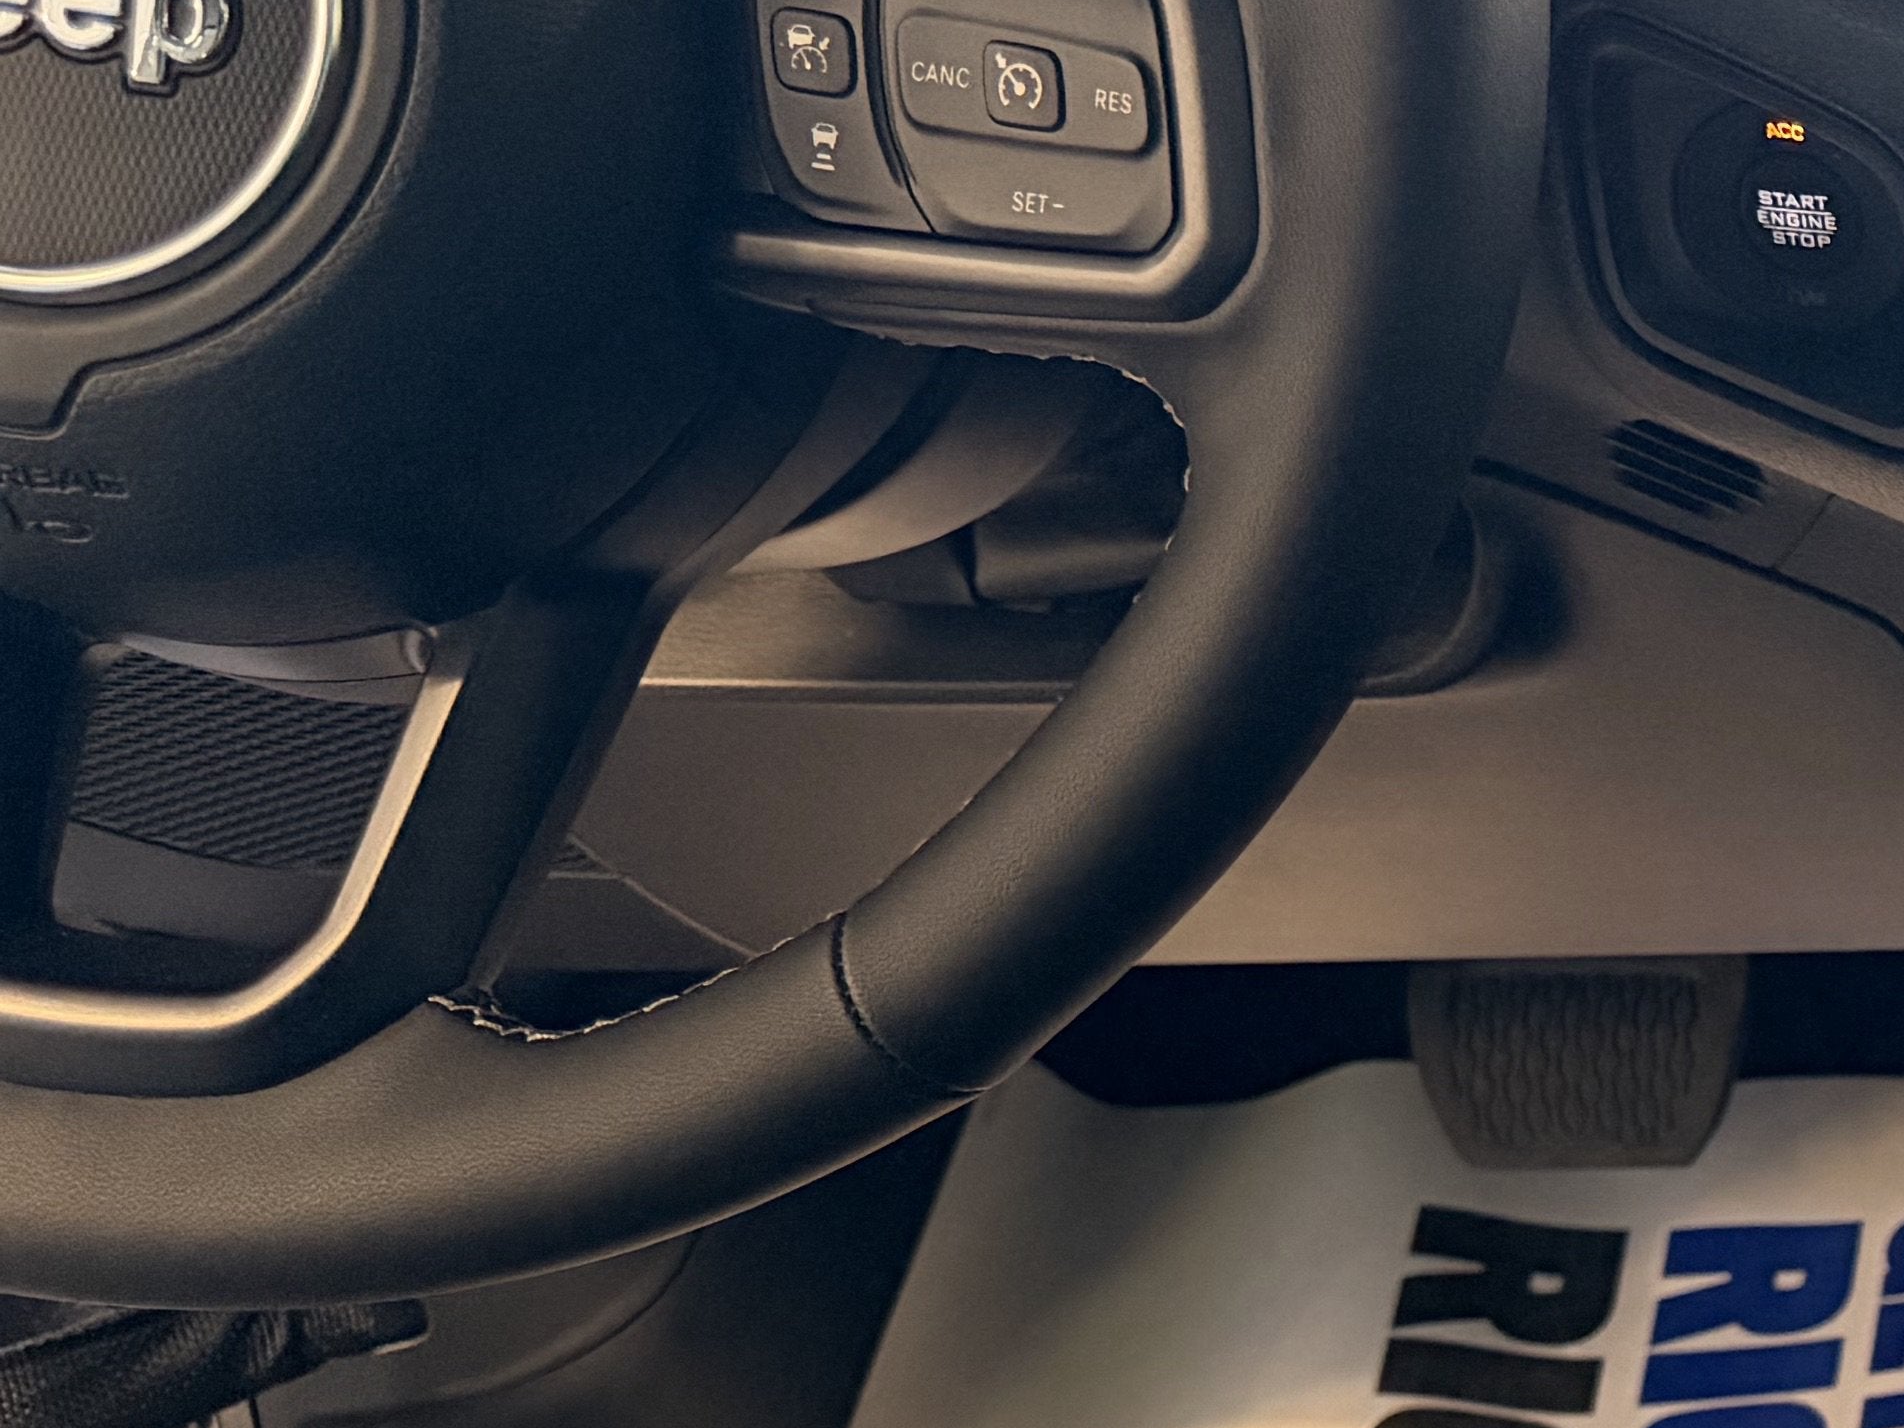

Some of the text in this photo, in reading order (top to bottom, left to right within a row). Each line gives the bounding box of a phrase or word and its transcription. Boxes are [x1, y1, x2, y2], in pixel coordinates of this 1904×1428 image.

[910, 62, 971, 88] CANC
[1094, 88, 1132, 115] RES
[1766, 121, 1805, 143] ACC
[1757, 189, 1828, 211] START
[1757, 209, 1838, 231] ENGINE
[1773, 230, 1832, 249] STOP
